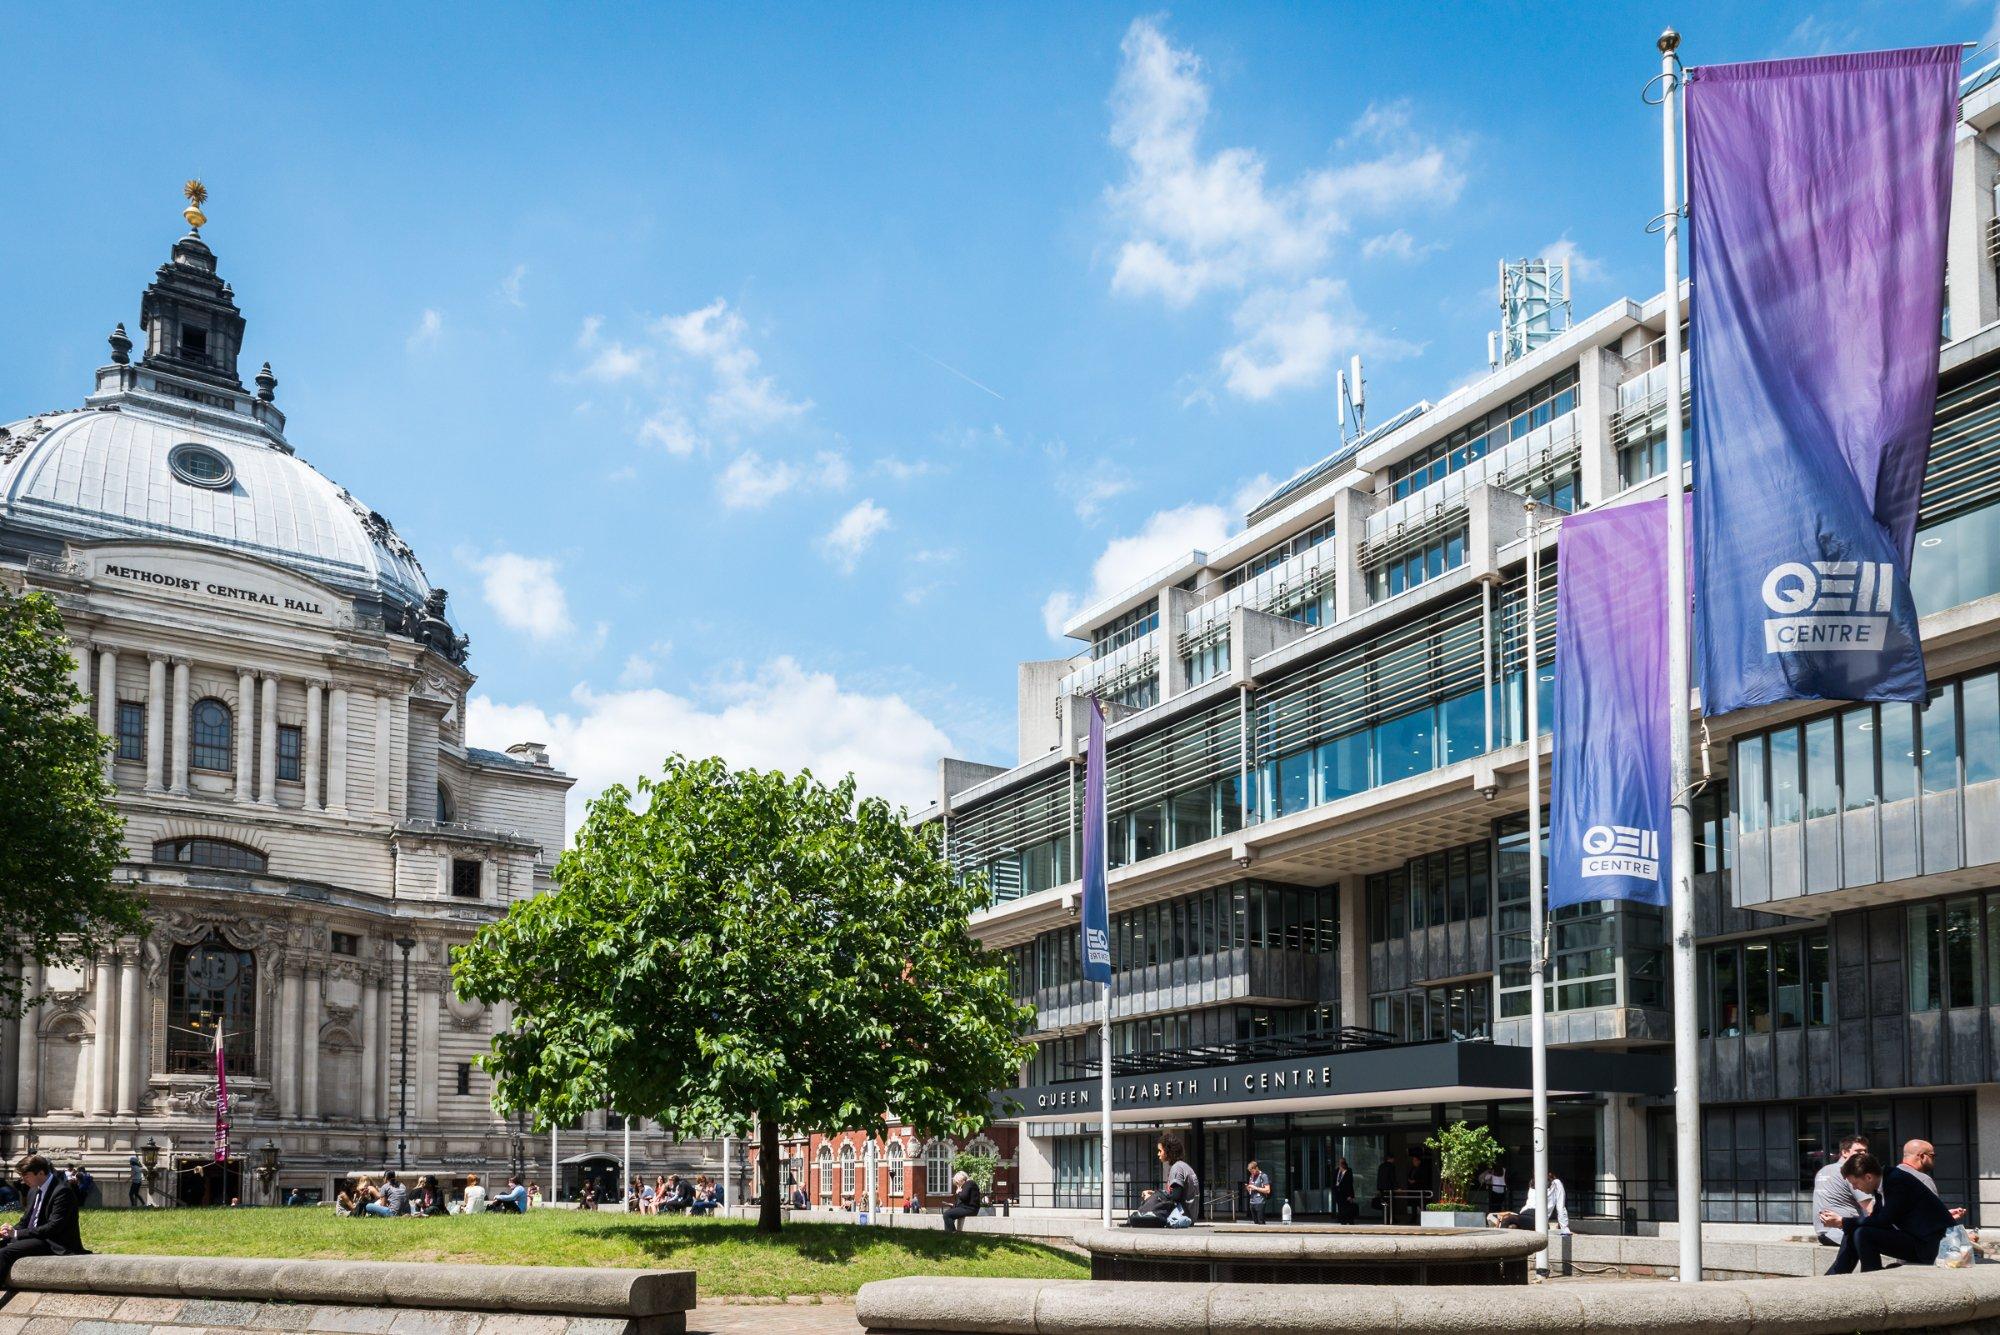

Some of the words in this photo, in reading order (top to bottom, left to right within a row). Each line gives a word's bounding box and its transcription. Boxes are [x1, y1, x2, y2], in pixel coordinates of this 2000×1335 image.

[105, 565, 200, 591] METHODIST
[207, 584, 278, 606] CENTRAL
[284, 598, 322, 614] HALL
[1761, 561, 1894, 614] QEII
[1777, 624, 1872, 644] CENTRE
[1582, 825, 1659, 860] QEII
[1589, 860, 1651, 875] CENTRE
[1038, 1090, 1088, 1107] QUEEN
[1101, 1079, 1197, 1101] LIZABETH
[1213, 1077, 1228, 1092] II
[1244, 1067, 1330, 1090] CENTRE
